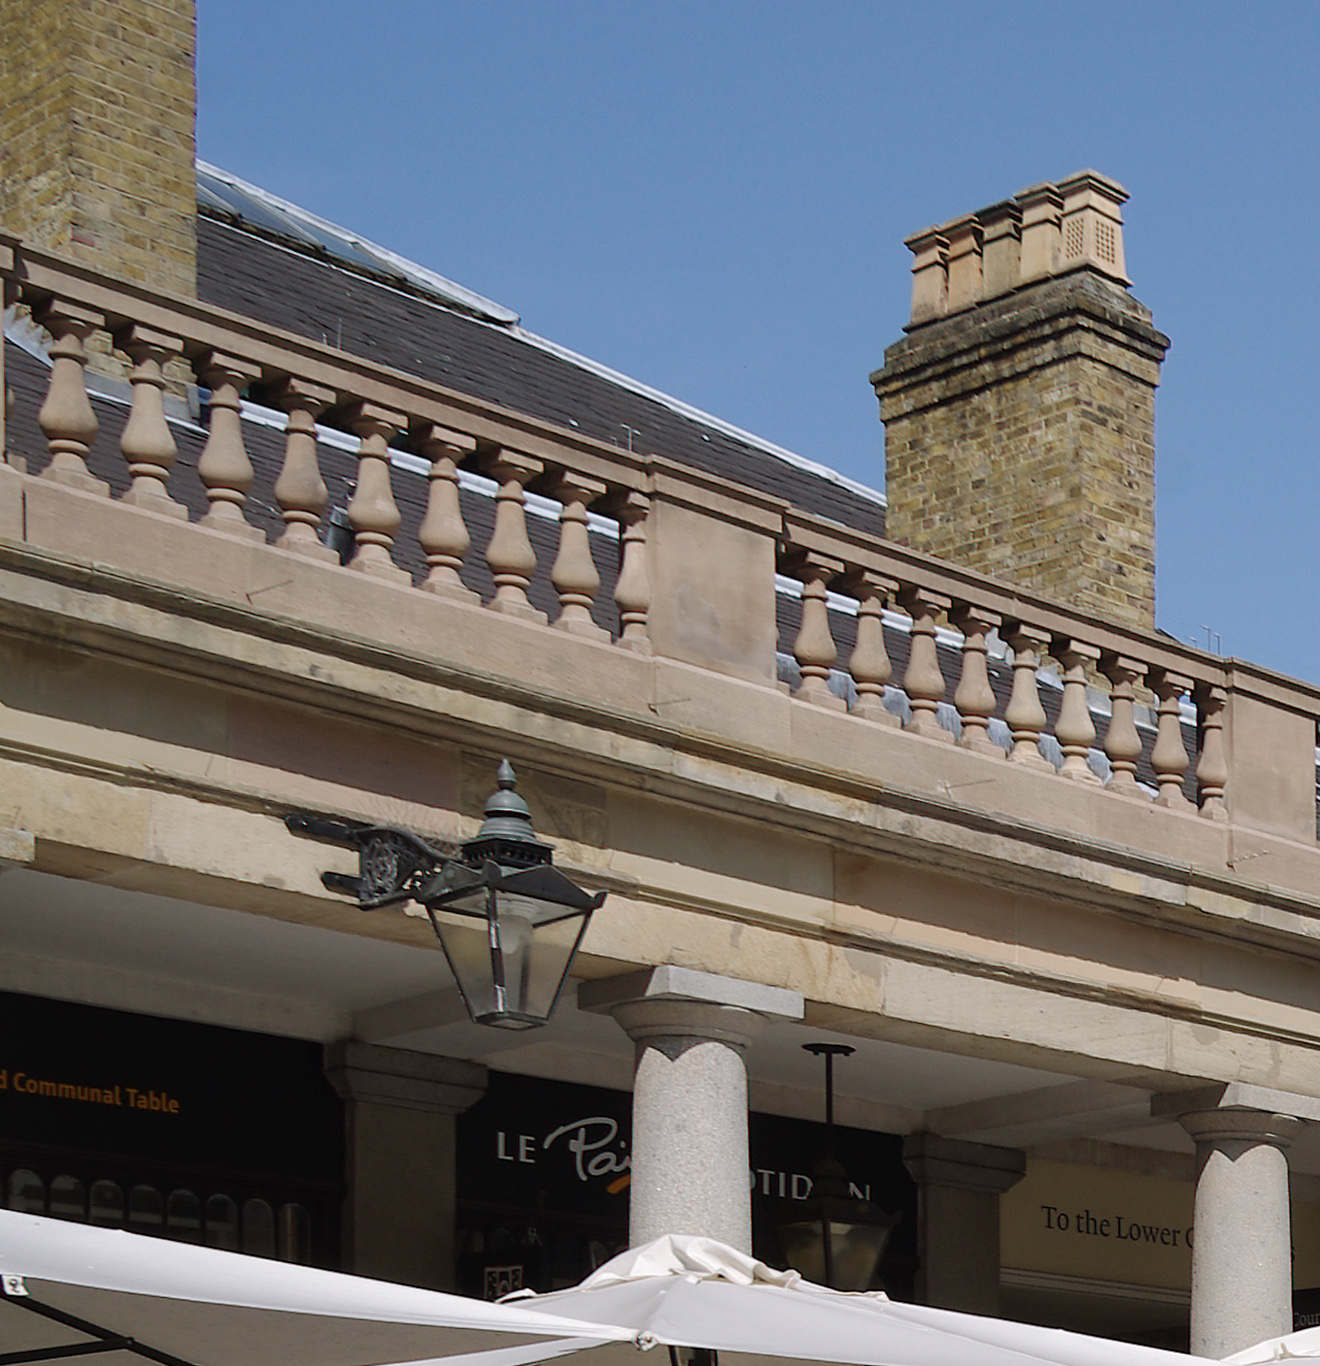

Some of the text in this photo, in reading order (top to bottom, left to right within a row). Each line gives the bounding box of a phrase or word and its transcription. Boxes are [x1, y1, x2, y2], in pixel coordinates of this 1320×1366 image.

[12, 1072, 123, 1106] Communal
[125, 1087, 180, 1114] Table
[496, 1130, 536, 1164] LE
[1041, 1205, 1069, 1231] To
[1076, 1210, 1110, 1237] the
[1115, 1216, 1180, 1247] Lower
